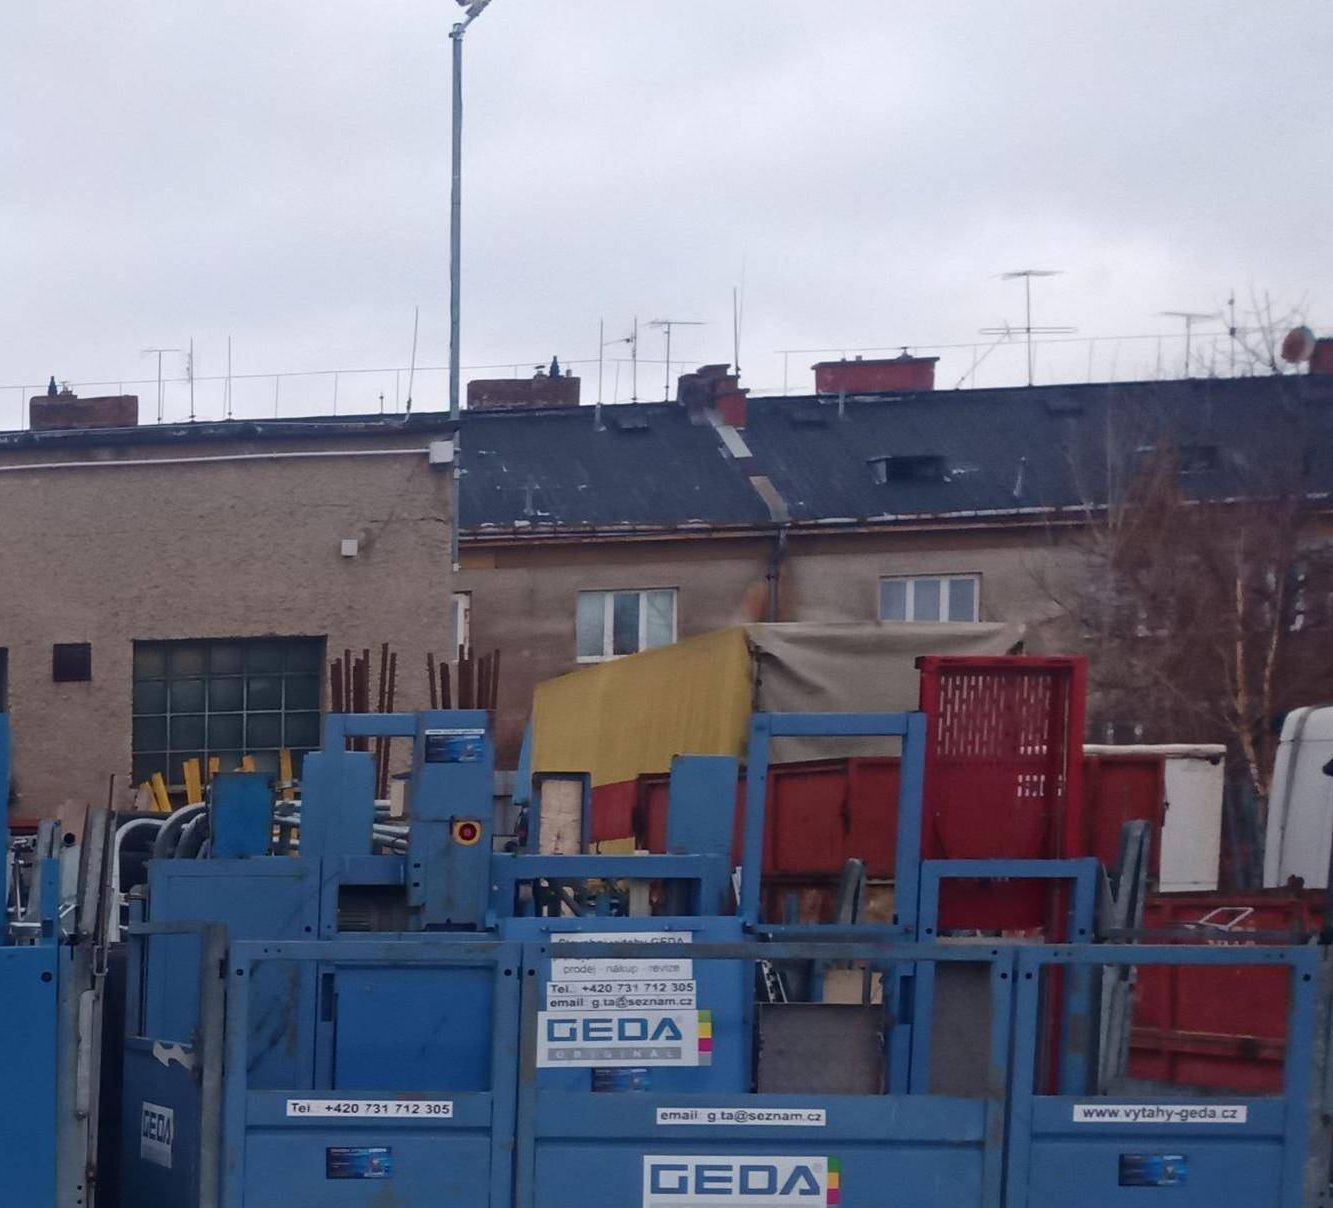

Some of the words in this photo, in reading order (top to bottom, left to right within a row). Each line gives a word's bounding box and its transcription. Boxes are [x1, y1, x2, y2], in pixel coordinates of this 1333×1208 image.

[582, 983, 612, 993] +420
[617, 983, 638, 993] 731
[644, 982, 666, 992] 712
[672, 982, 694, 992] 305
[547, 1017, 682, 1042] GEDA
[556, 1049, 673, 1060] ORIGINAL
[325, 1103, 359, 1114] +420
[365, 1103, 388, 1114] 731
[395, 1104, 420, 1114] 712
[426, 1104, 450, 1114] 305
[650, 1164, 821, 1196] GEDA
